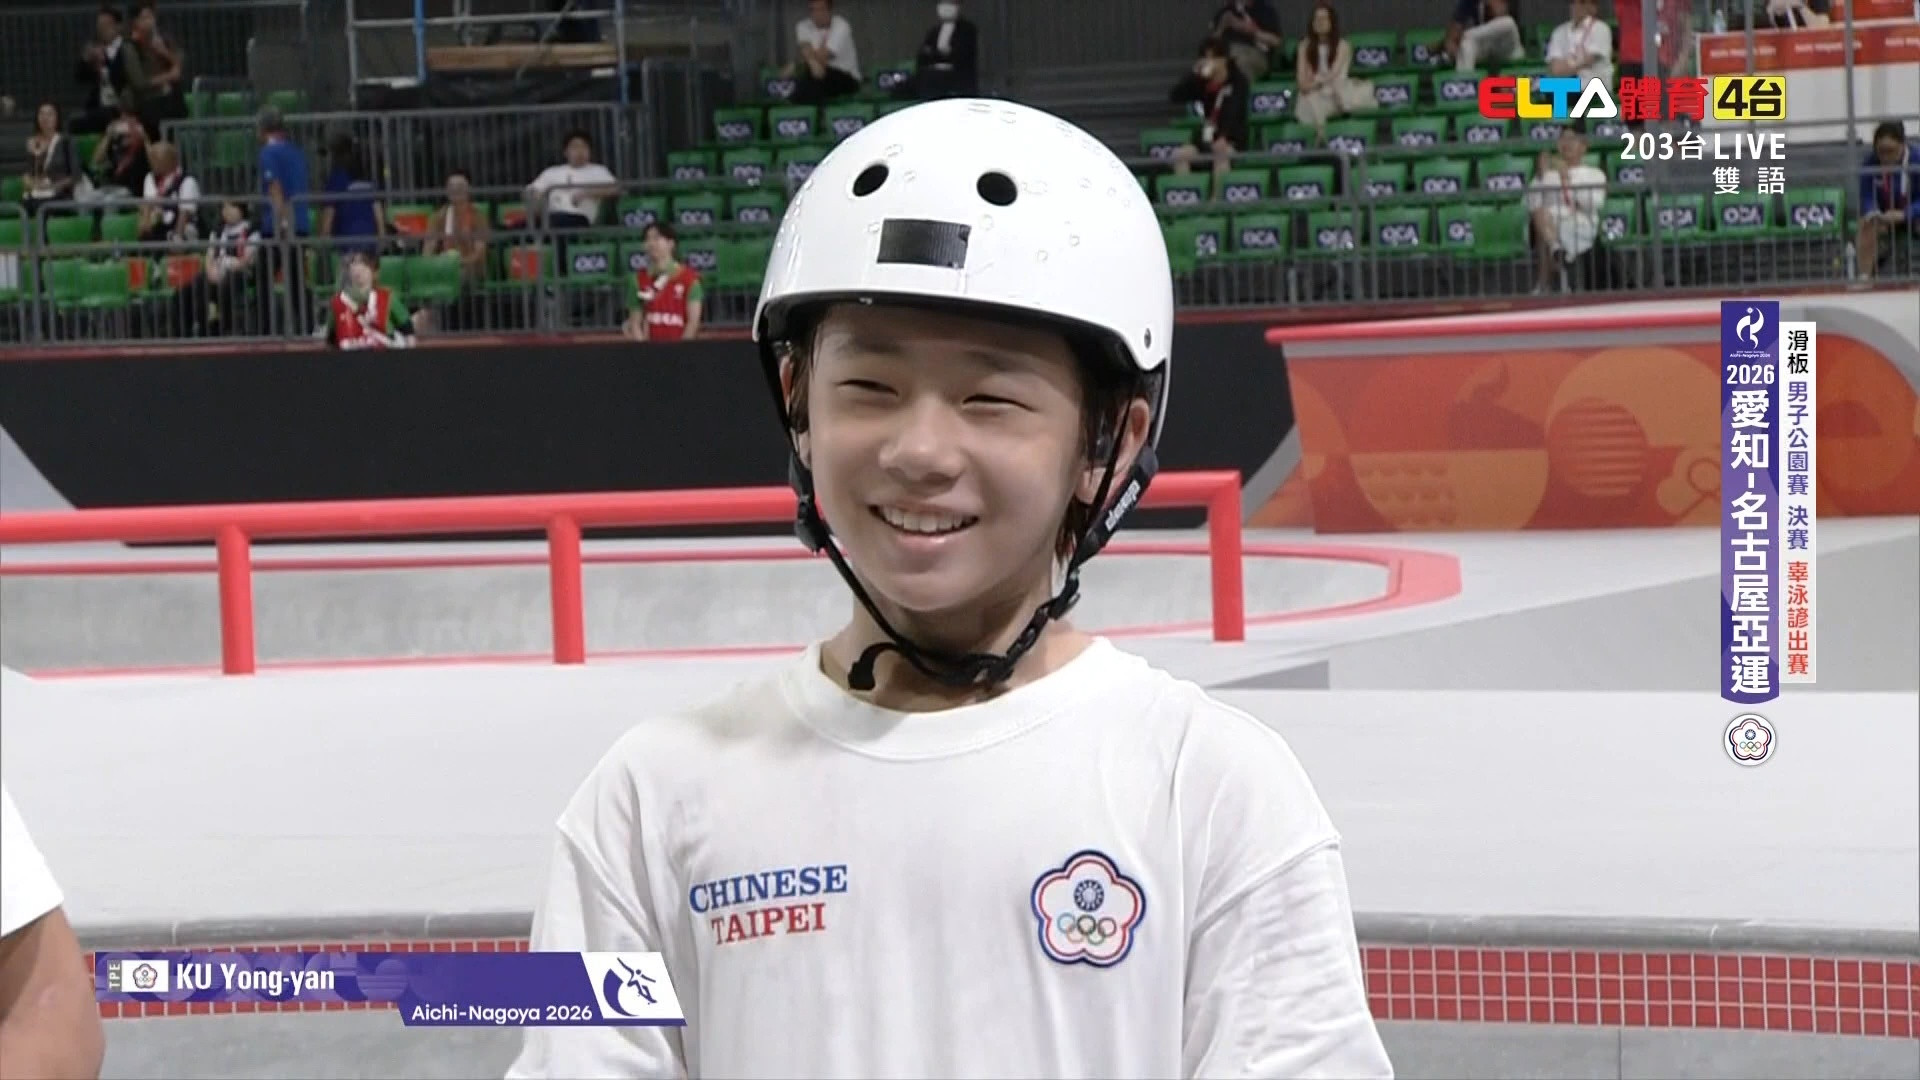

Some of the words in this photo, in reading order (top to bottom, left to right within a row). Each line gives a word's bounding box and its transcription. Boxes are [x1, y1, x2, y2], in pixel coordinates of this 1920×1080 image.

[1423, 178, 1458, 194] OCA
[1724, 205, 1761, 224] OCA
[1243, 229, 1277, 247] OCA
[1381, 224, 1418, 244] OCA
[689, 864, 848, 914] CHINESE
[711, 903, 828, 945] TAIPEI
